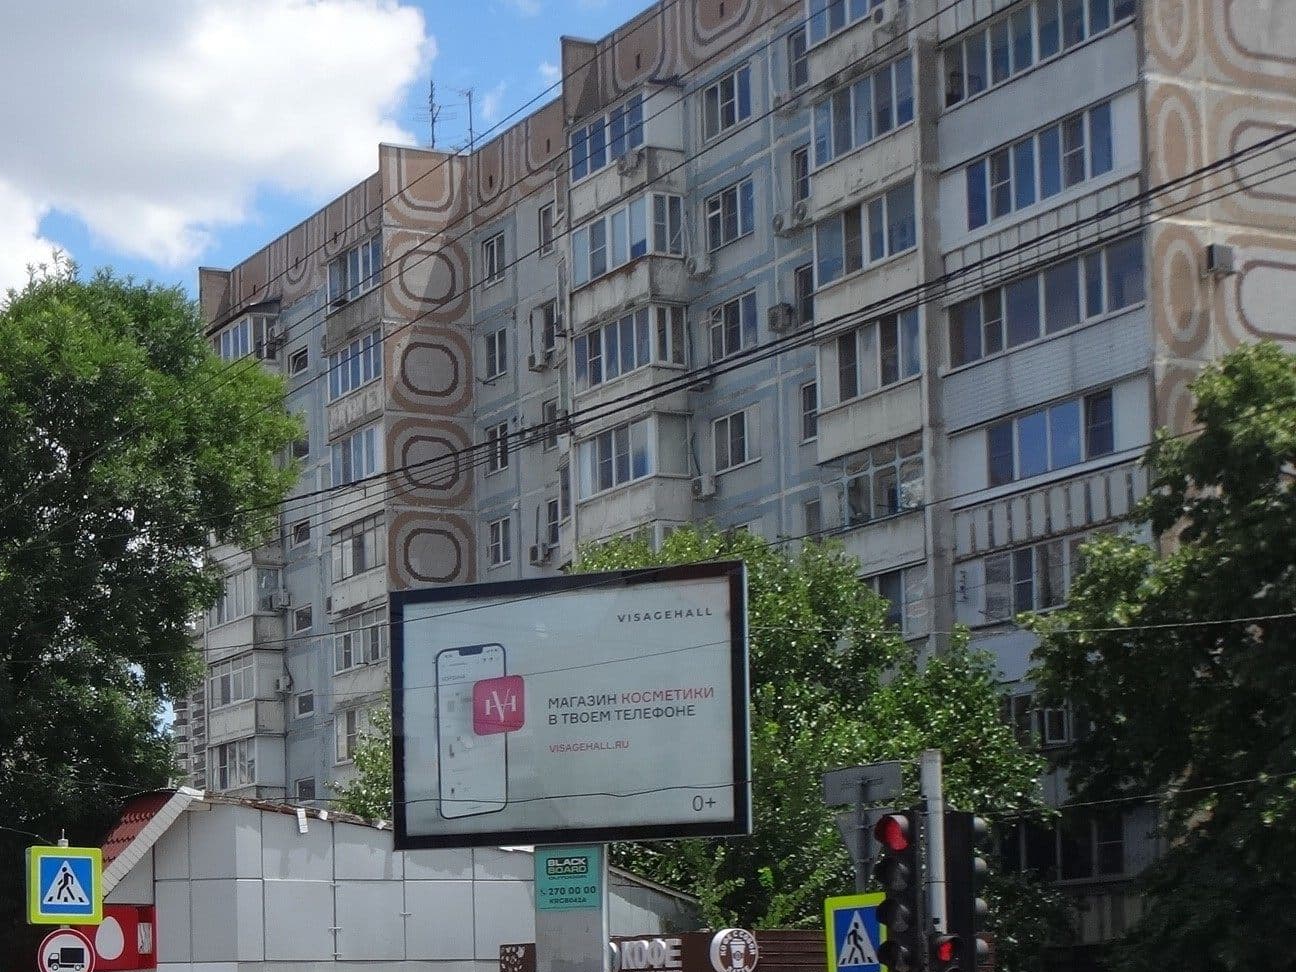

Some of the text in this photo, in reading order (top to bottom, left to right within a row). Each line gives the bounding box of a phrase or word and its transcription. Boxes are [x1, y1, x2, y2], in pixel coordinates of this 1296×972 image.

[617, 608, 713, 623] VISAGEHALL
[548, 687, 714, 709] МАГАЗИН КОСМЕТИКИ
[548, 705, 696, 725] В ТВОЕМ ТЕЛЕФОНЕ
[549, 740, 630, 753] VISAGEHALL.RU
[692, 795, 716, 812] 0+
[547, 858, 586, 867] BLACK
[548, 866, 587, 874] BOARD
[548, 886, 596, 896] 270 00 00
[621, 938, 682, 969] КОФЕ
